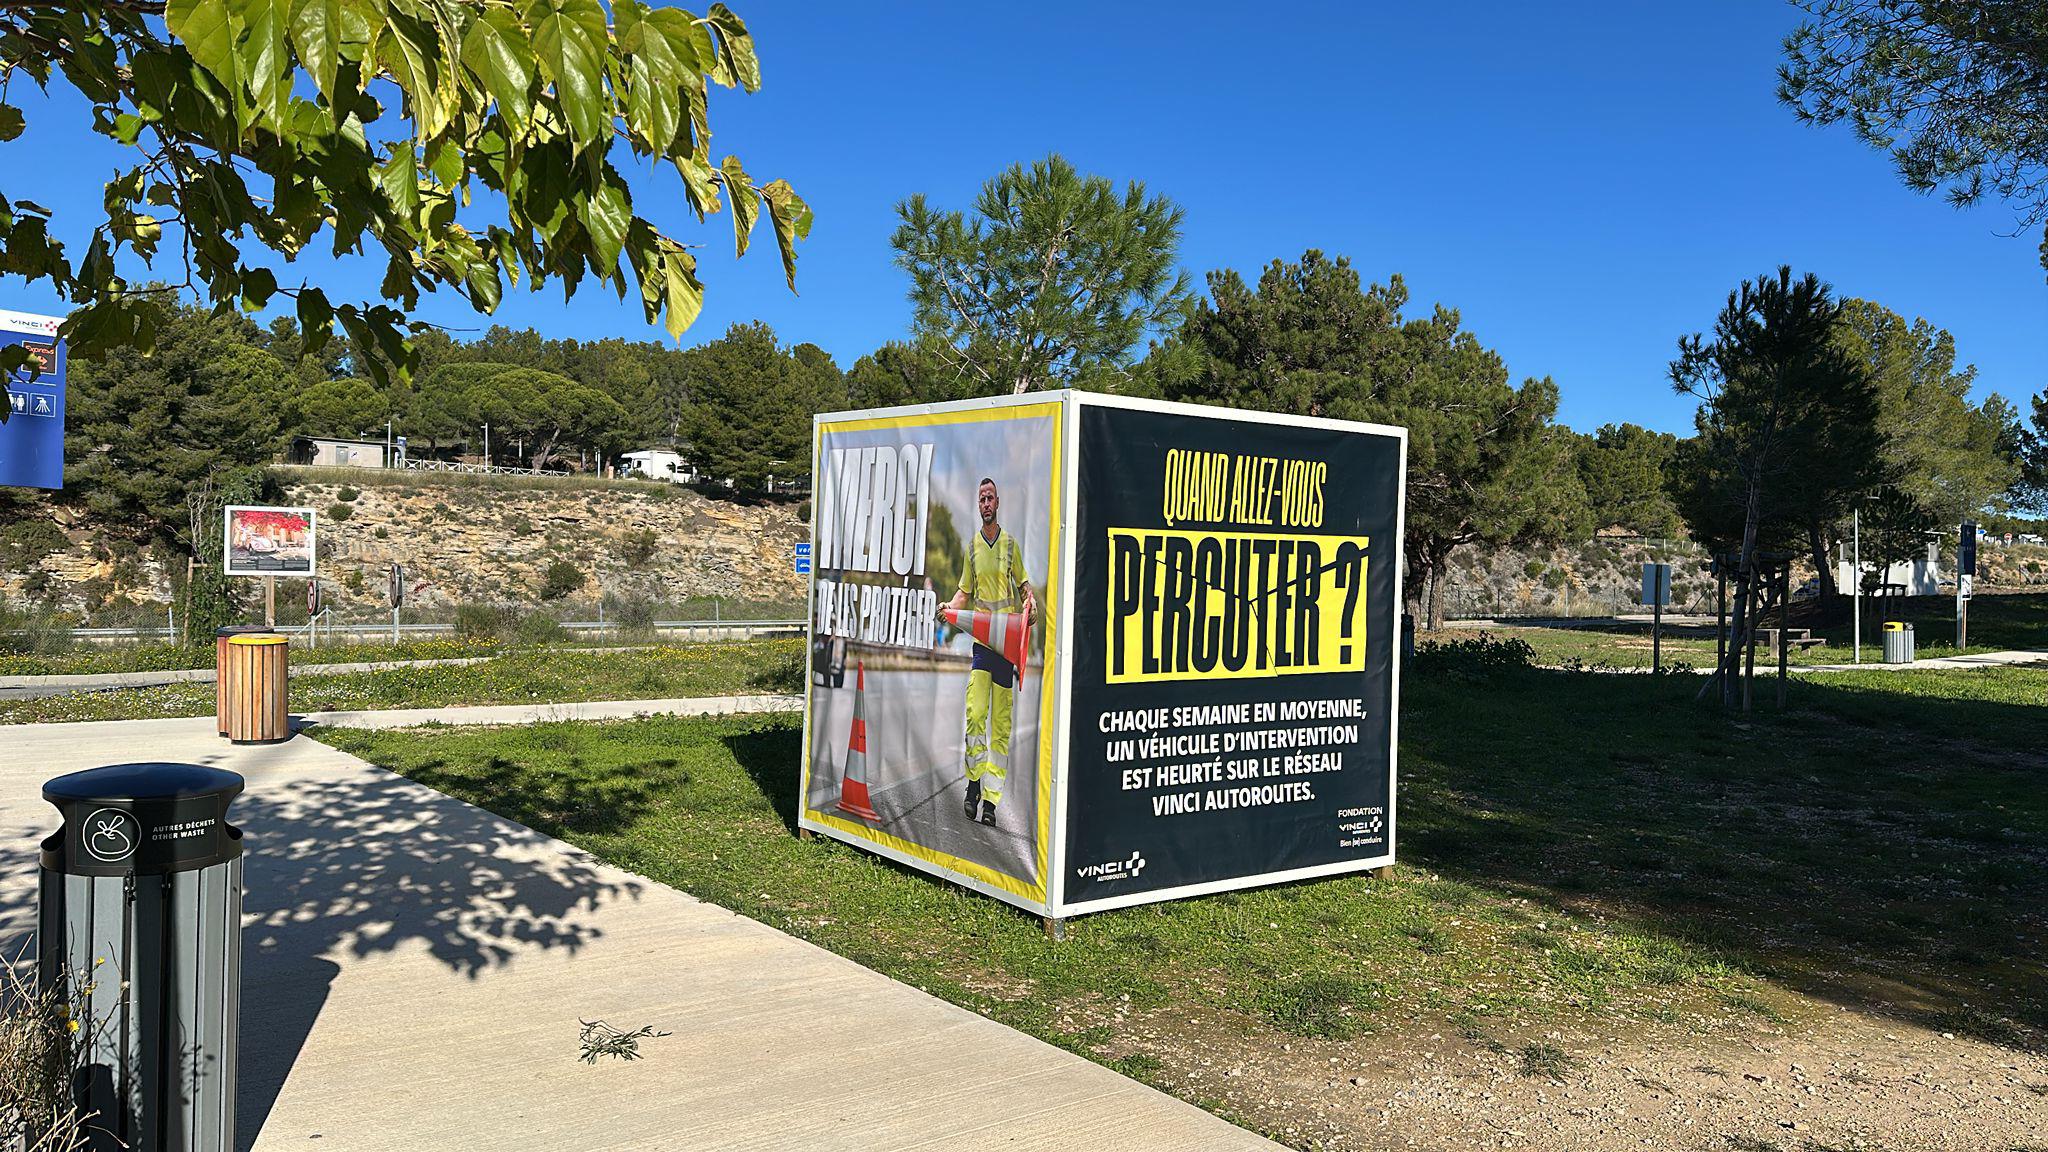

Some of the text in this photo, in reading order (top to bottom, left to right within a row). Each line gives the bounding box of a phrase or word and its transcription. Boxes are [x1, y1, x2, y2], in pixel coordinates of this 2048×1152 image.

[10, 320, 42, 328] VINCI
[1163, 448, 1327, 528] QUAND ALLEZ-VOUS
[820, 444, 934, 575] MERCI
[816, 576, 937, 650] DE LES PROTÉGER
[1113, 534, 1321, 676] PERCUTER
[1099, 699, 1367, 733] CHAQUE SEMAINE EN MOYENNE,
[1106, 725, 1358, 762] UN VÉHICULE D'INTERVENTION
[1122, 749, 1342, 790] EST HEURTÉ SUR LE RÉSEAU
[1152, 781, 1316, 817] VINCI AUTOROUTES.
[1338, 806, 1382, 817] FONDATION
[152, 818, 214, 832] AUTRES DÉCHETS
[180, 828, 204, 838] WASTE
[1339, 822, 1367, 831] VINCI
[1077, 861, 1123, 878] VINCI
